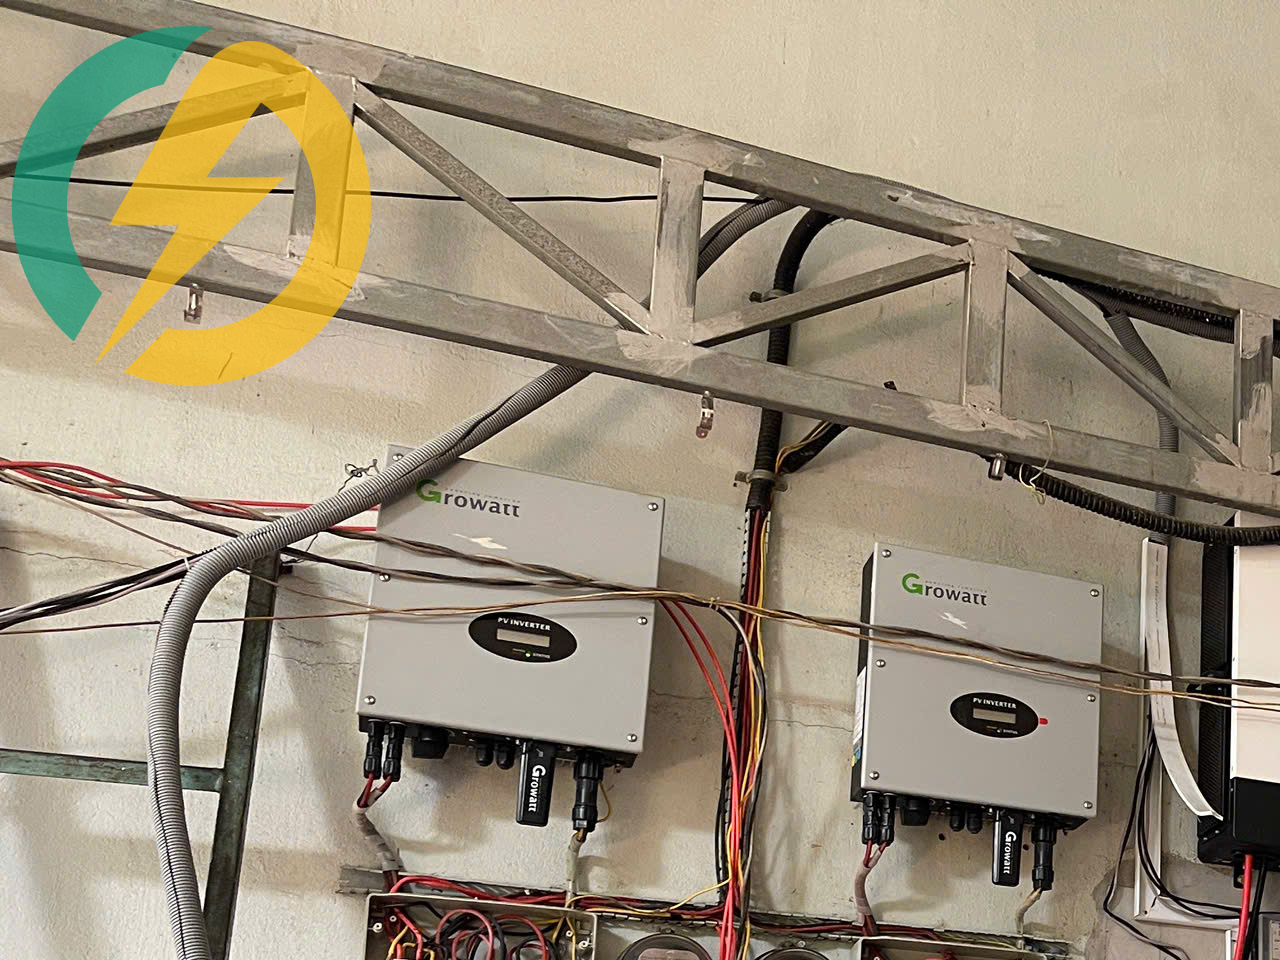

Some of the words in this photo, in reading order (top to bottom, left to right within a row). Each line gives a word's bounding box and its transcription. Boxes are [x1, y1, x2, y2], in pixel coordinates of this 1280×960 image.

[416, 479, 520, 518] Growatt
[902, 573, 987, 606] Growatt
[510, 619, 551, 631] INVERTER
[983, 699, 1017, 709] INVERTER
[528, 764, 546, 812] Growatt
[1003, 831, 1017, 874] Growatt
